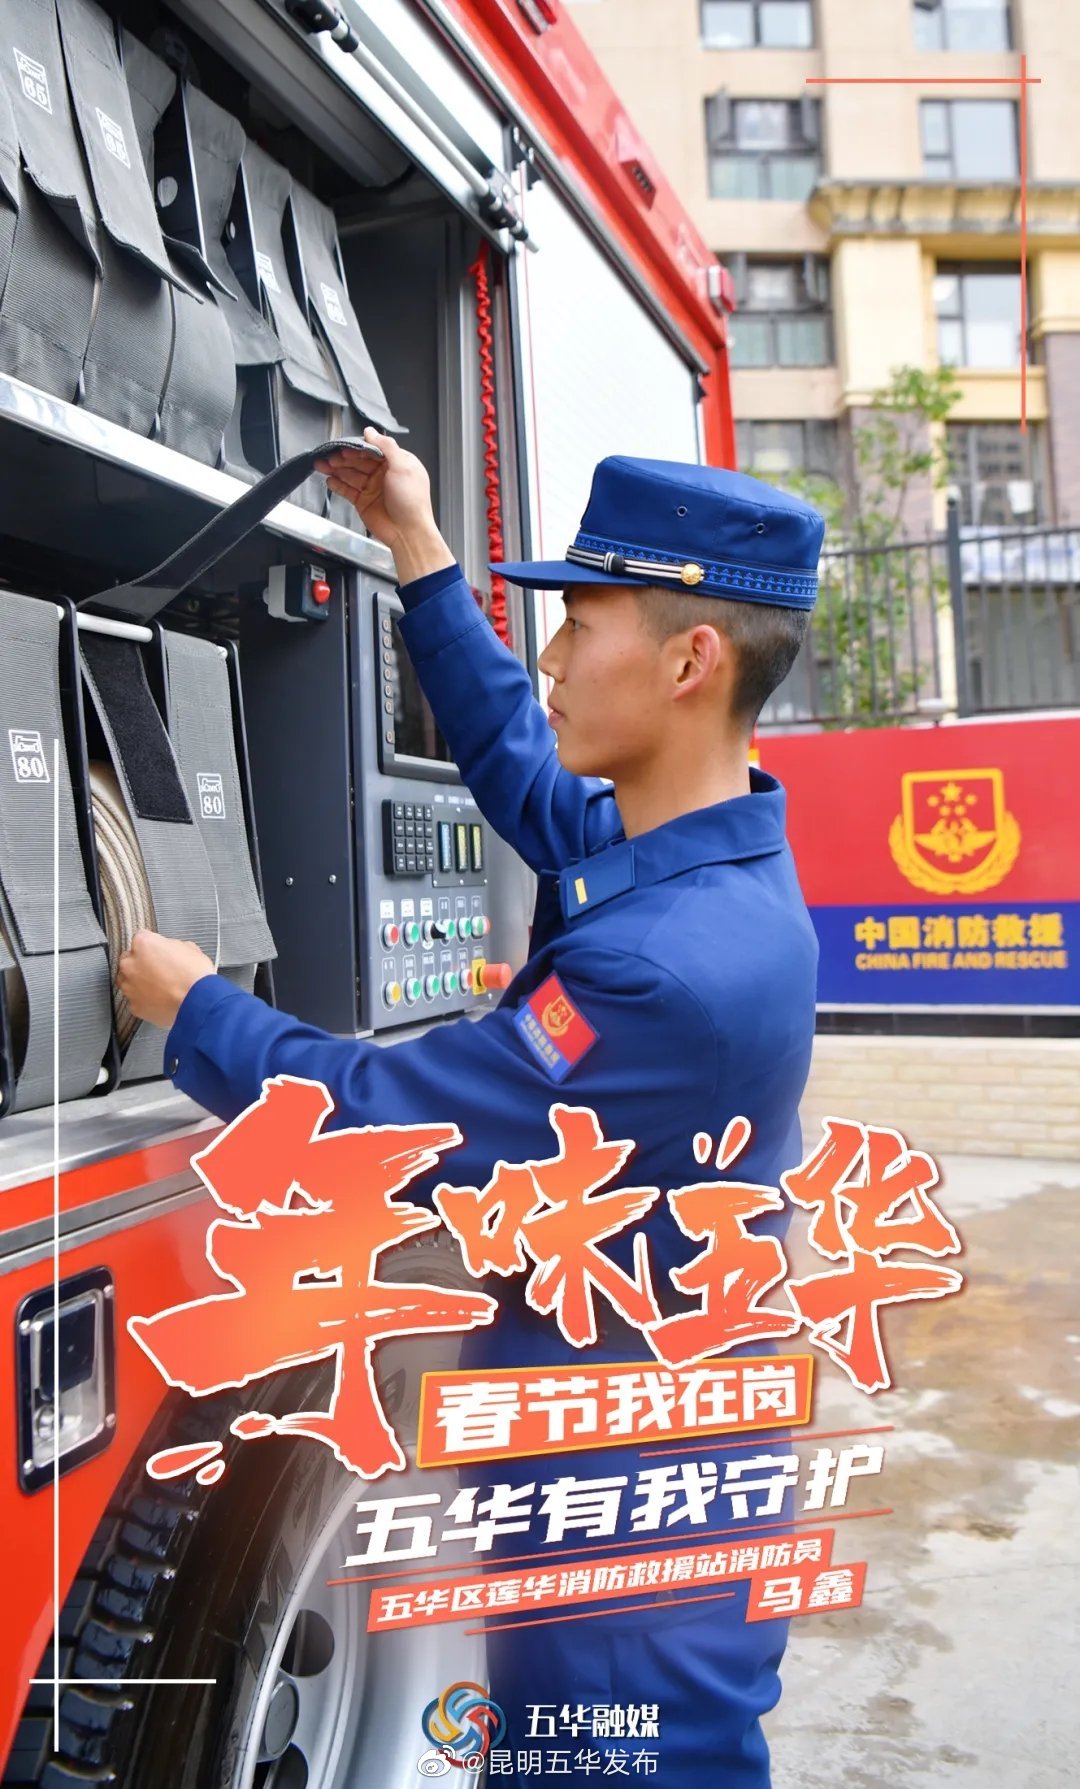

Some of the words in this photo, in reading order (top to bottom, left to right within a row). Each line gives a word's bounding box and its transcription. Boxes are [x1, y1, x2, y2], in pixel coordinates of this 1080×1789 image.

[17, 756, 44, 778] 80
[203, 795, 222, 815] 80
[855, 913, 1063, 950] 中国消防救援
[855, 952, 910, 971] CHINA
[912, 952, 950, 970] FIRE
[953, 951, 993, 969] AND
[995, 950, 1067, 969] RESCUE
